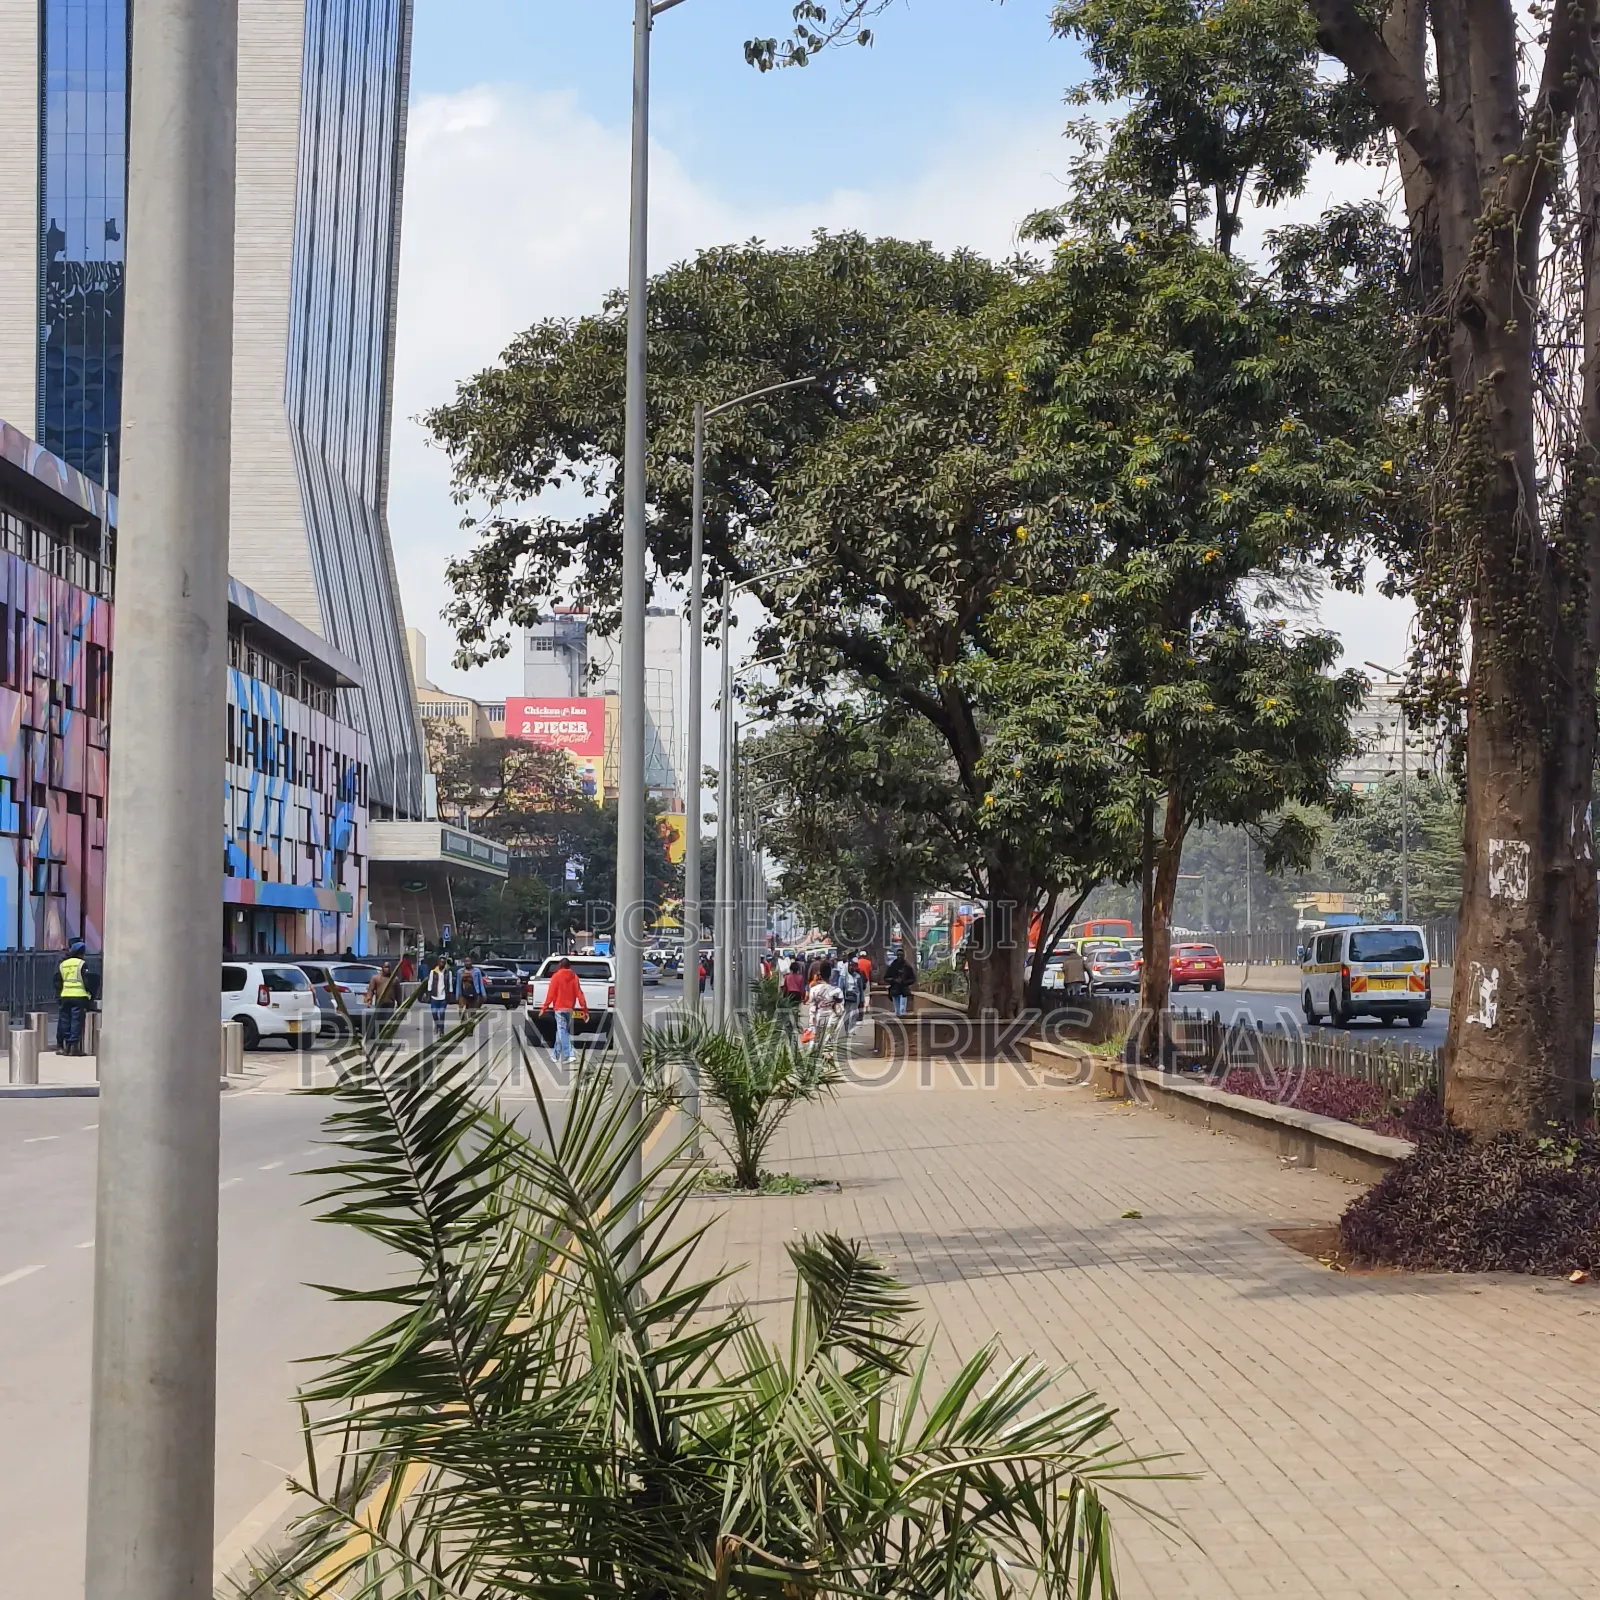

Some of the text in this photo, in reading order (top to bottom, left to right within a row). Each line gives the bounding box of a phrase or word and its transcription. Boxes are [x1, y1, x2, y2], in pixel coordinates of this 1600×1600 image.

[524, 706, 586, 715] Chicken Inn
[522, 722, 531, 733] 2
